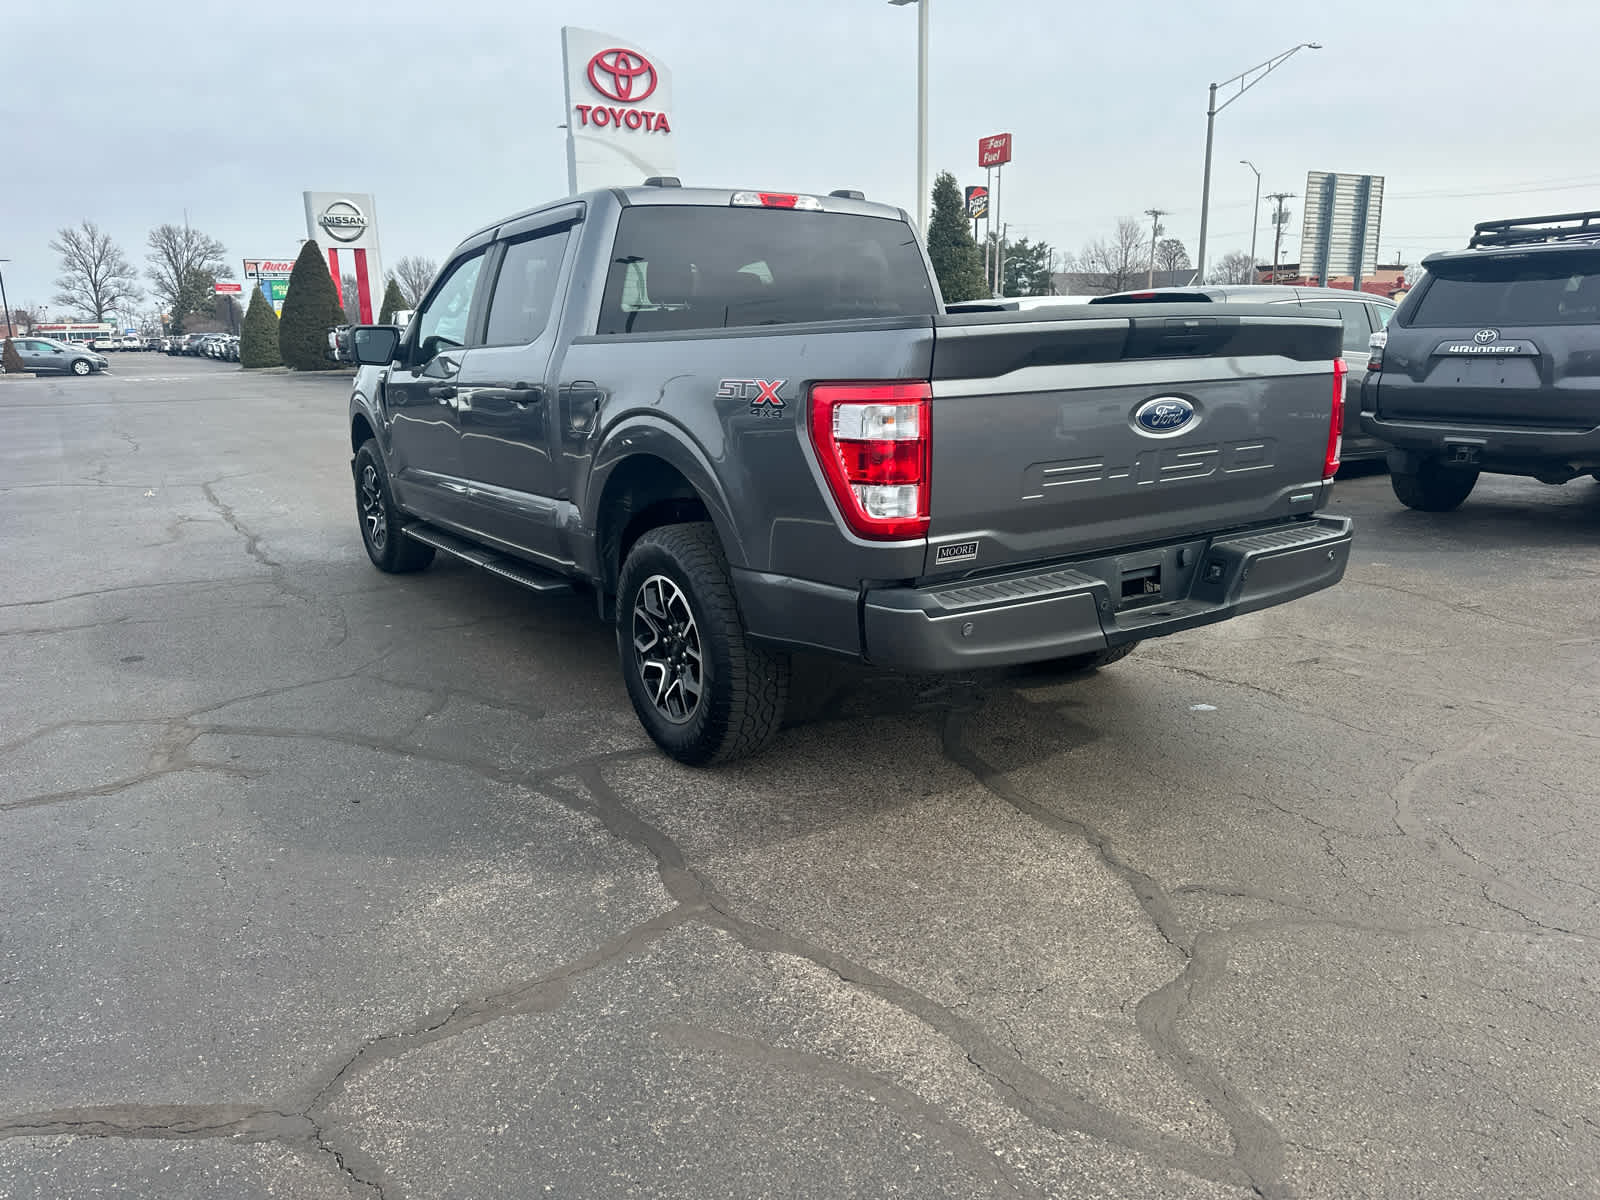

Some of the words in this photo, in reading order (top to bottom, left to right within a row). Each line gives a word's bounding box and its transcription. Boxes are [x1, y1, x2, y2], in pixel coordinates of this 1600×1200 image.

[576, 104, 671, 133] TOYOTA
[986, 138, 1006, 150] Fast
[983, 150, 1000, 163] Fuel
[323, 216, 365, 225] NISSAN
[716, 379, 786, 408] STX
[1152, 405, 1184, 426] Ford
[1021, 438, 1278, 500] F-150
[940, 544, 976, 558] MOORE
